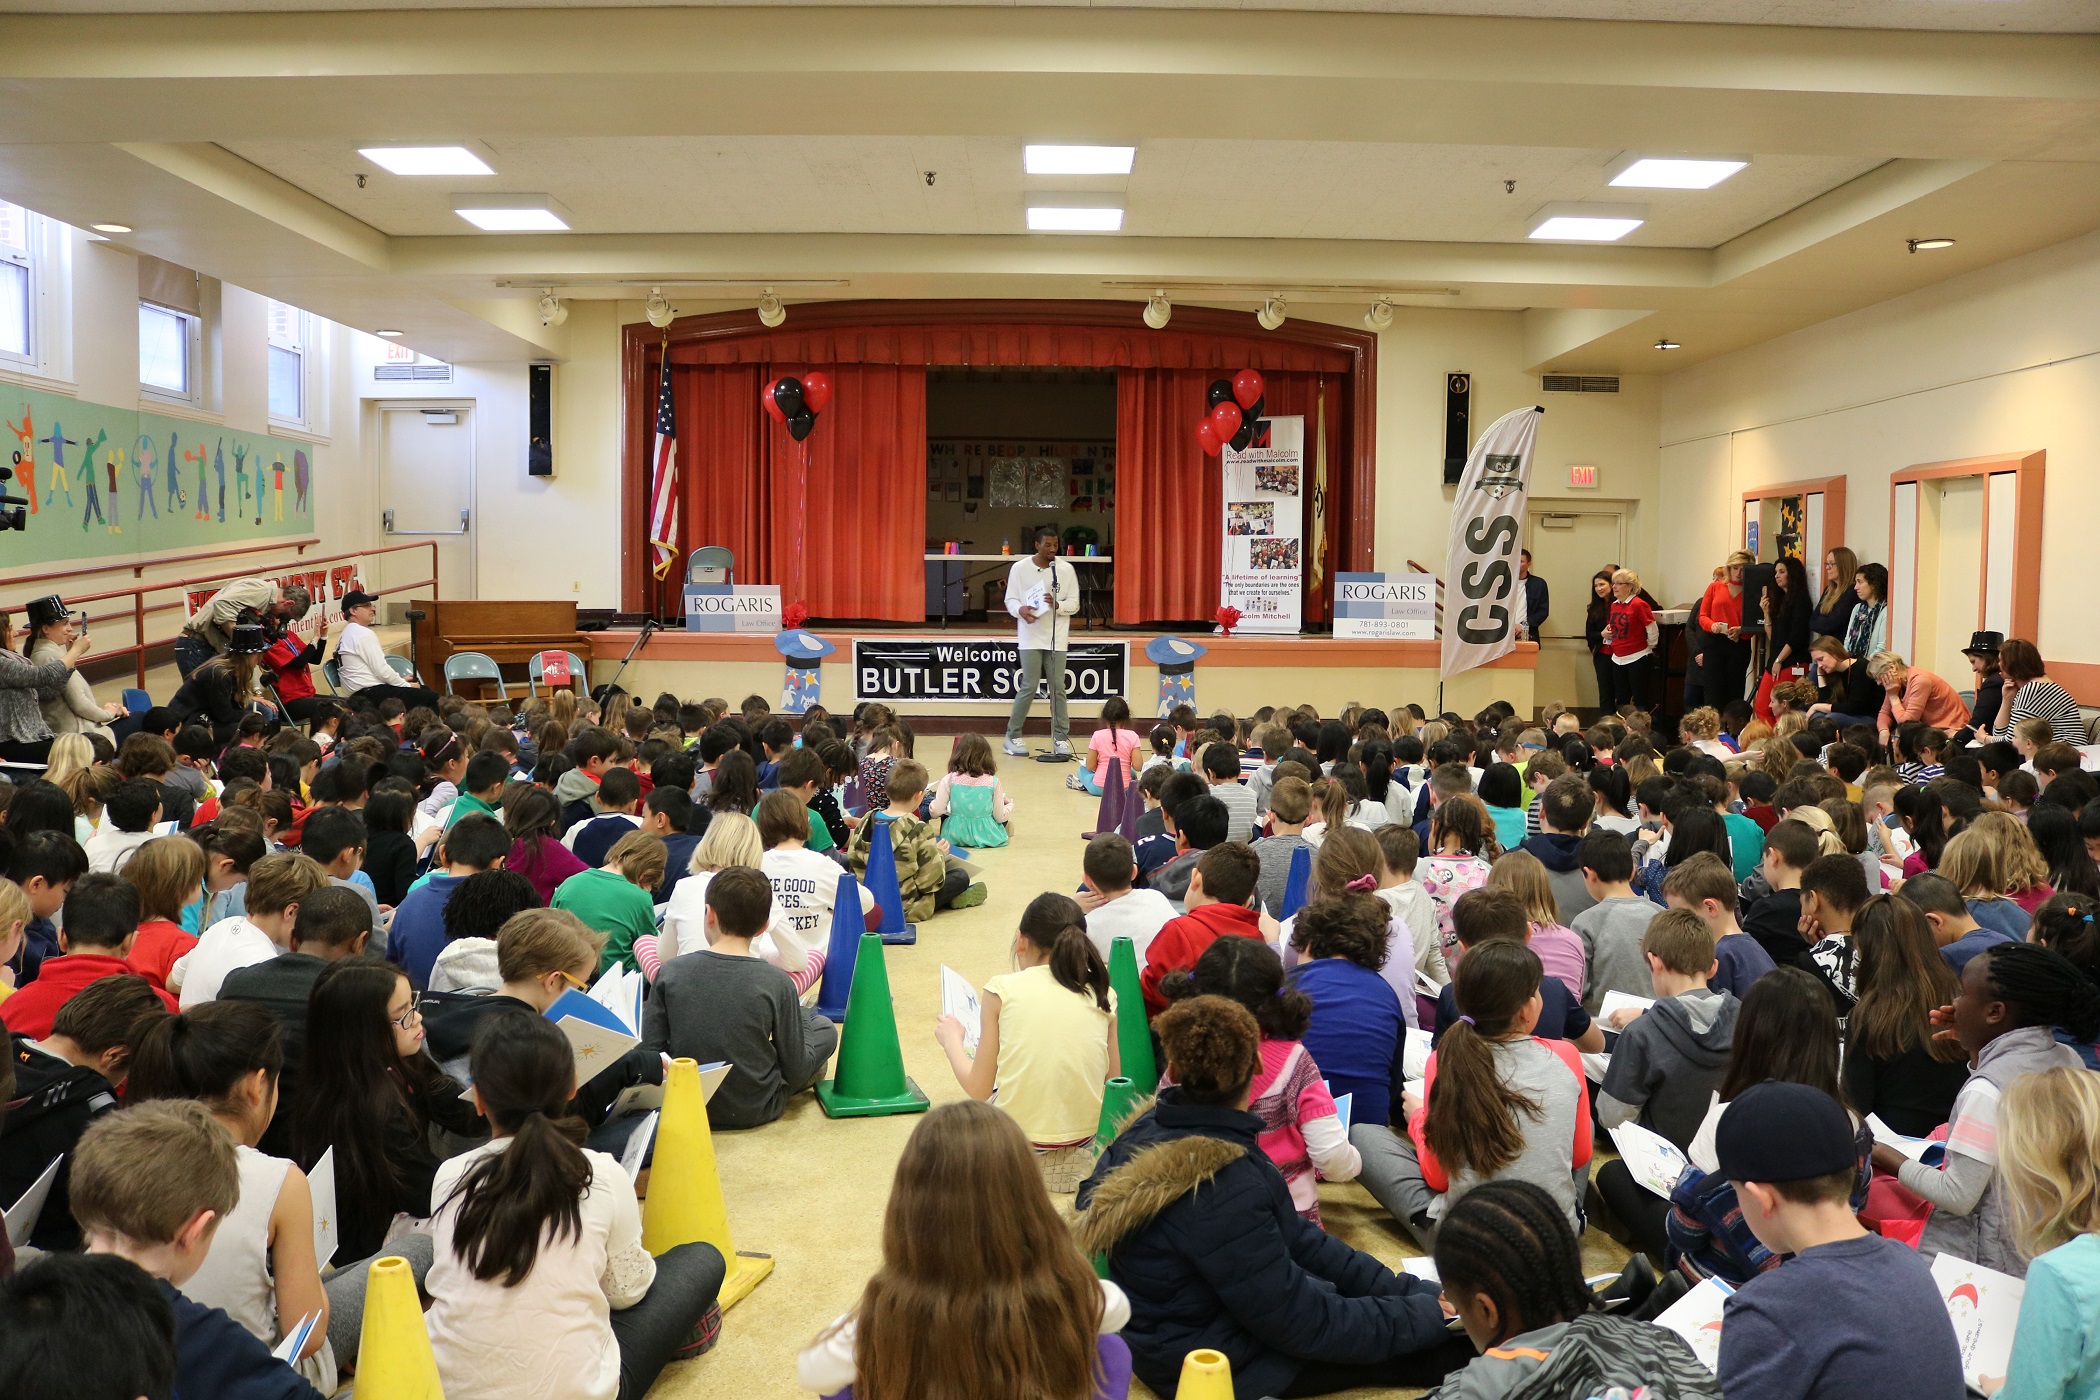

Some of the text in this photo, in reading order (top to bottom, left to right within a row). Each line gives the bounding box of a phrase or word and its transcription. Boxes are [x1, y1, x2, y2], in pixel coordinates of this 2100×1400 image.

[387, 341, 408, 359] EXIT
[930, 443, 982, 456] WHRE
[1226, 448, 1299, 460] Read with Malcolm
[1495, 461, 1512, 472] CSS
[1571, 466, 1595, 485] EXIT
[1457, 514, 1519, 645] CSS
[1342, 584, 1427, 601] ROGARIS
[693, 596, 773, 613] ROGARIS
[1391, 607, 1428, 616] Law Office
[741, 619, 776, 627] Law Office
[1359, 620, 1409, 629] 781-893-0801
[1351, 629, 1416, 638] www.rogarislaw.com
[936, 646, 1018, 662] Welcome
[862, 667, 982, 694] BUTLER
[784, 878, 816, 894] GOOD
[1963, 1318, 1985, 1370] your dreams?
[1965, 1329, 1973, 1343] are
